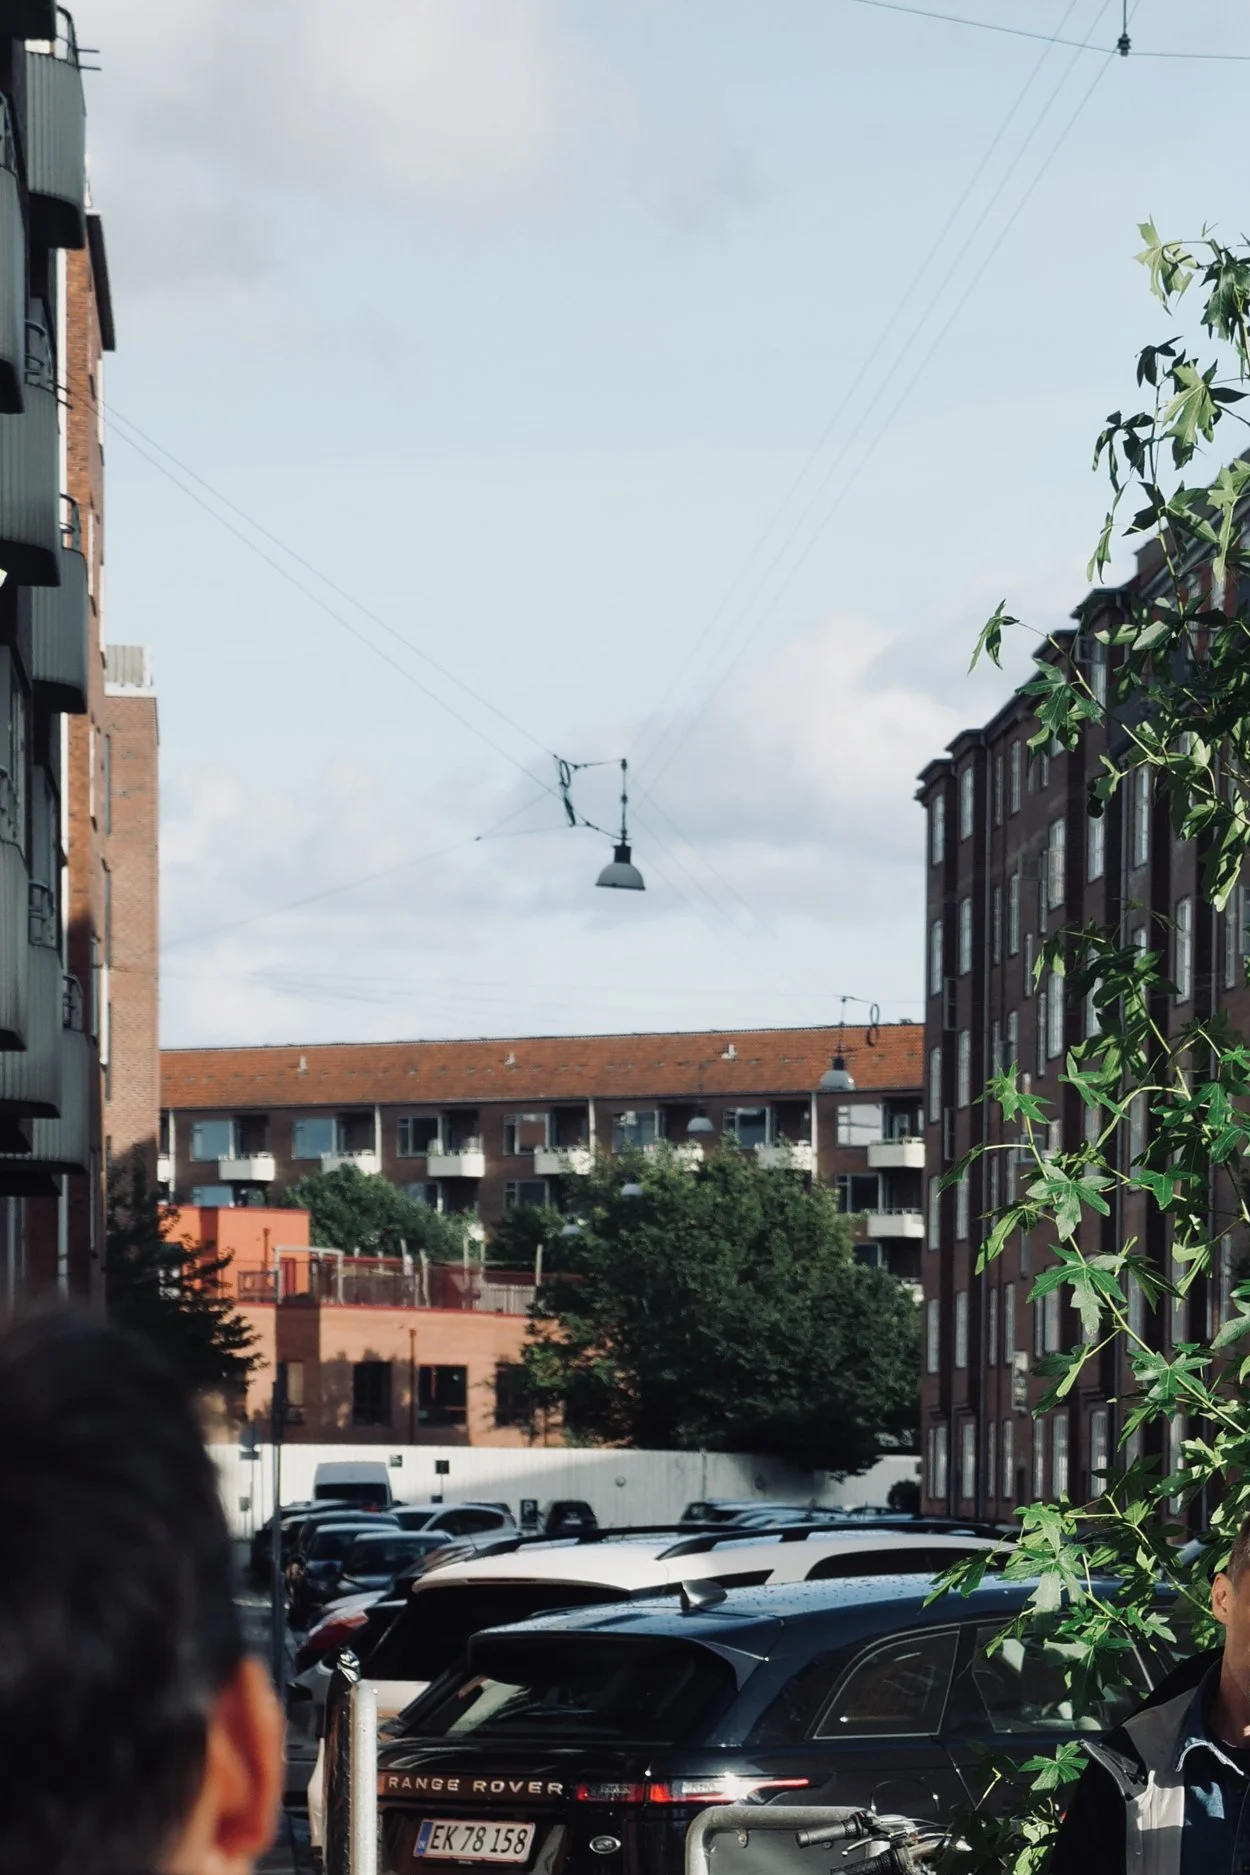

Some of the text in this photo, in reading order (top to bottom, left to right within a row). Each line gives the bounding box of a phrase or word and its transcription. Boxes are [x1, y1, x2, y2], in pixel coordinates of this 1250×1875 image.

[388, 1776, 564, 1795] RANGE ROVER
[430, 1825, 528, 1855] EK 78 158
